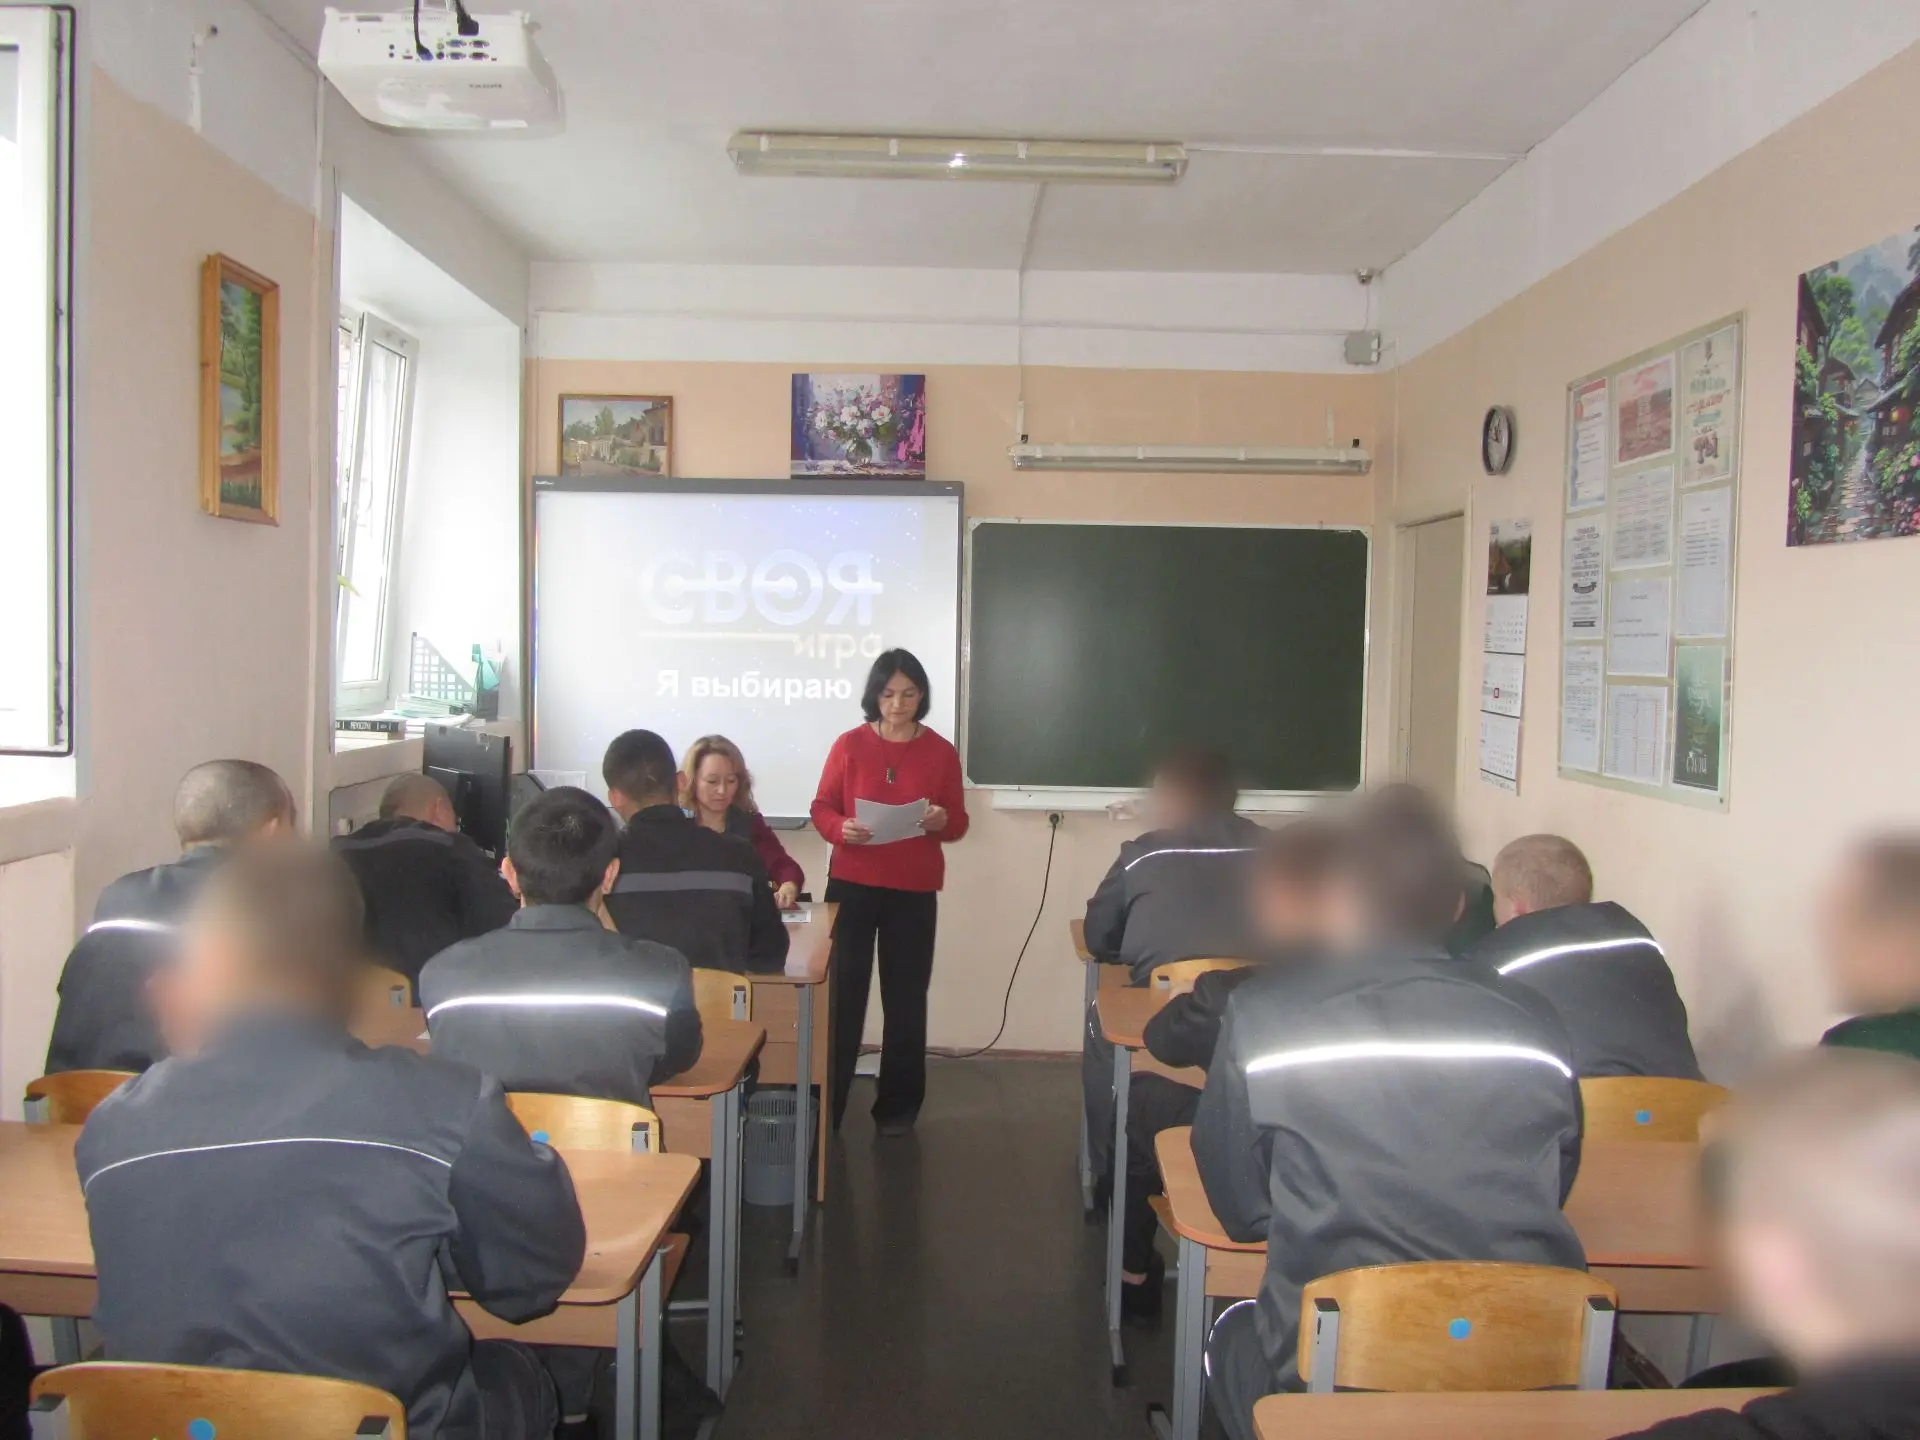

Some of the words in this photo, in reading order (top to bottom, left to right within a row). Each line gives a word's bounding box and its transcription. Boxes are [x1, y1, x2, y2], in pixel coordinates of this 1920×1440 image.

[638, 548, 884, 626] СВОЯ
[793, 631, 883, 669] игра
[655, 669, 680, 698] Я
[690, 671, 852, 706] выбираю
